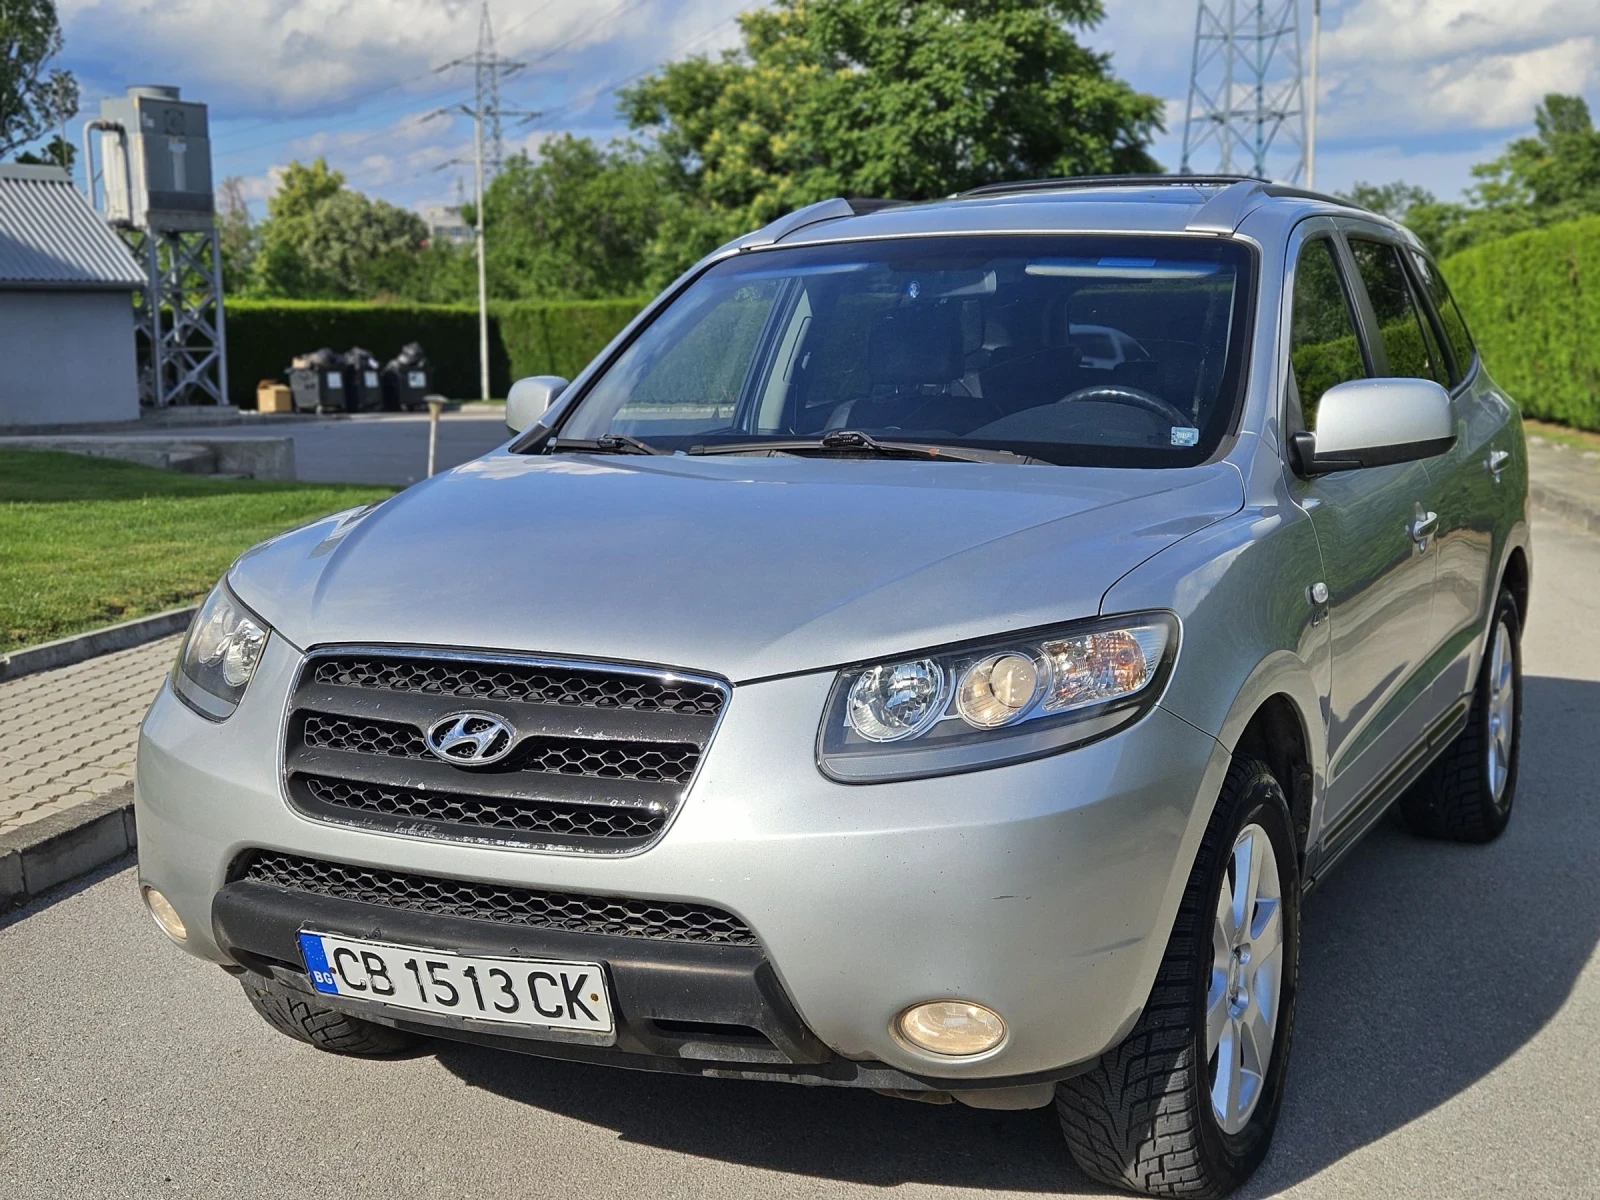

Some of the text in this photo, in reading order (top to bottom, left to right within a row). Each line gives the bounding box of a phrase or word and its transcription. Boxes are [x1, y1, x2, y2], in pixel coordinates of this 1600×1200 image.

[313, 969, 333, 985] BG
[332, 947, 600, 1022] CB 1513 CK
